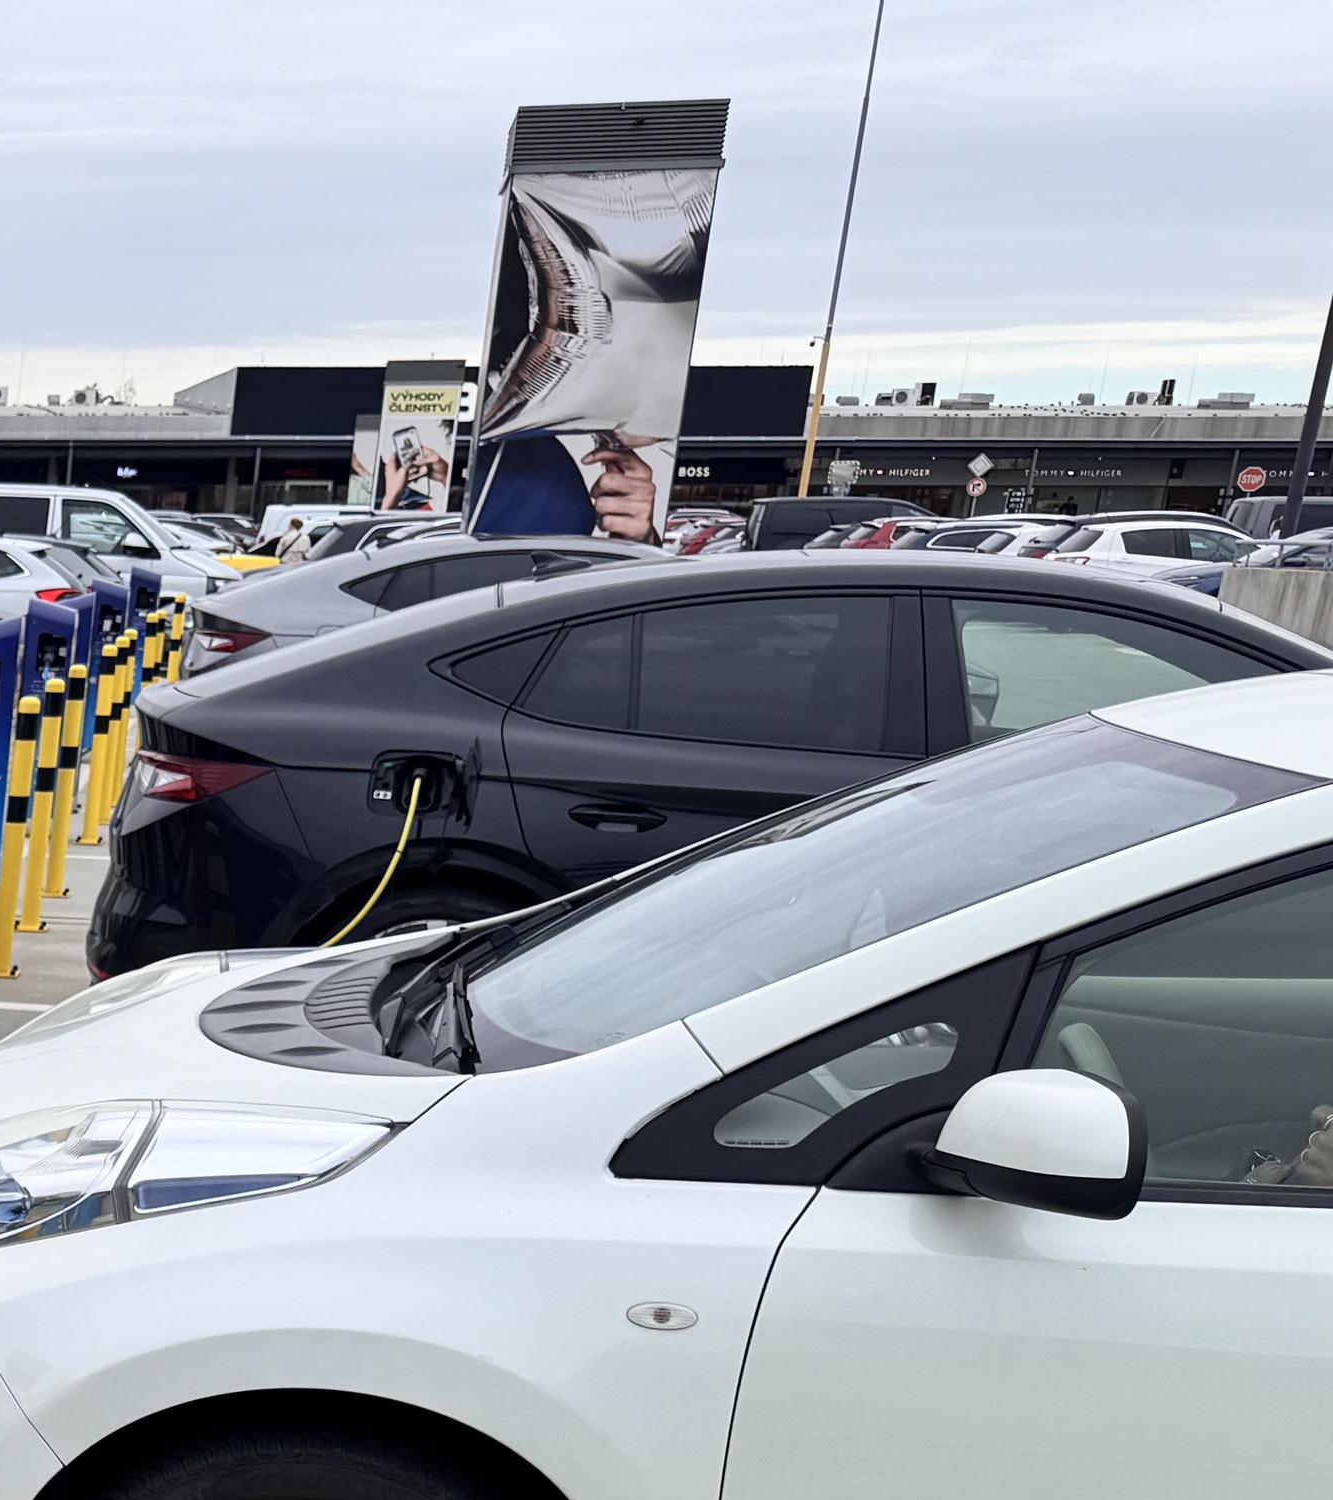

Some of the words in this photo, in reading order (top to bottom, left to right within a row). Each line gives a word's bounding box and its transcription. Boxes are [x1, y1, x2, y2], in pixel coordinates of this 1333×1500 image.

[390, 390, 444, 402] VÝHODY
[389, 402, 453, 413] ČLENSTVÍ
[678, 466, 710, 477] BOSS
[888, 469, 931, 477] HILFIGER
[1080, 469, 1122, 477] HILFIGER
[1241, 474, 1263, 484] STOP
